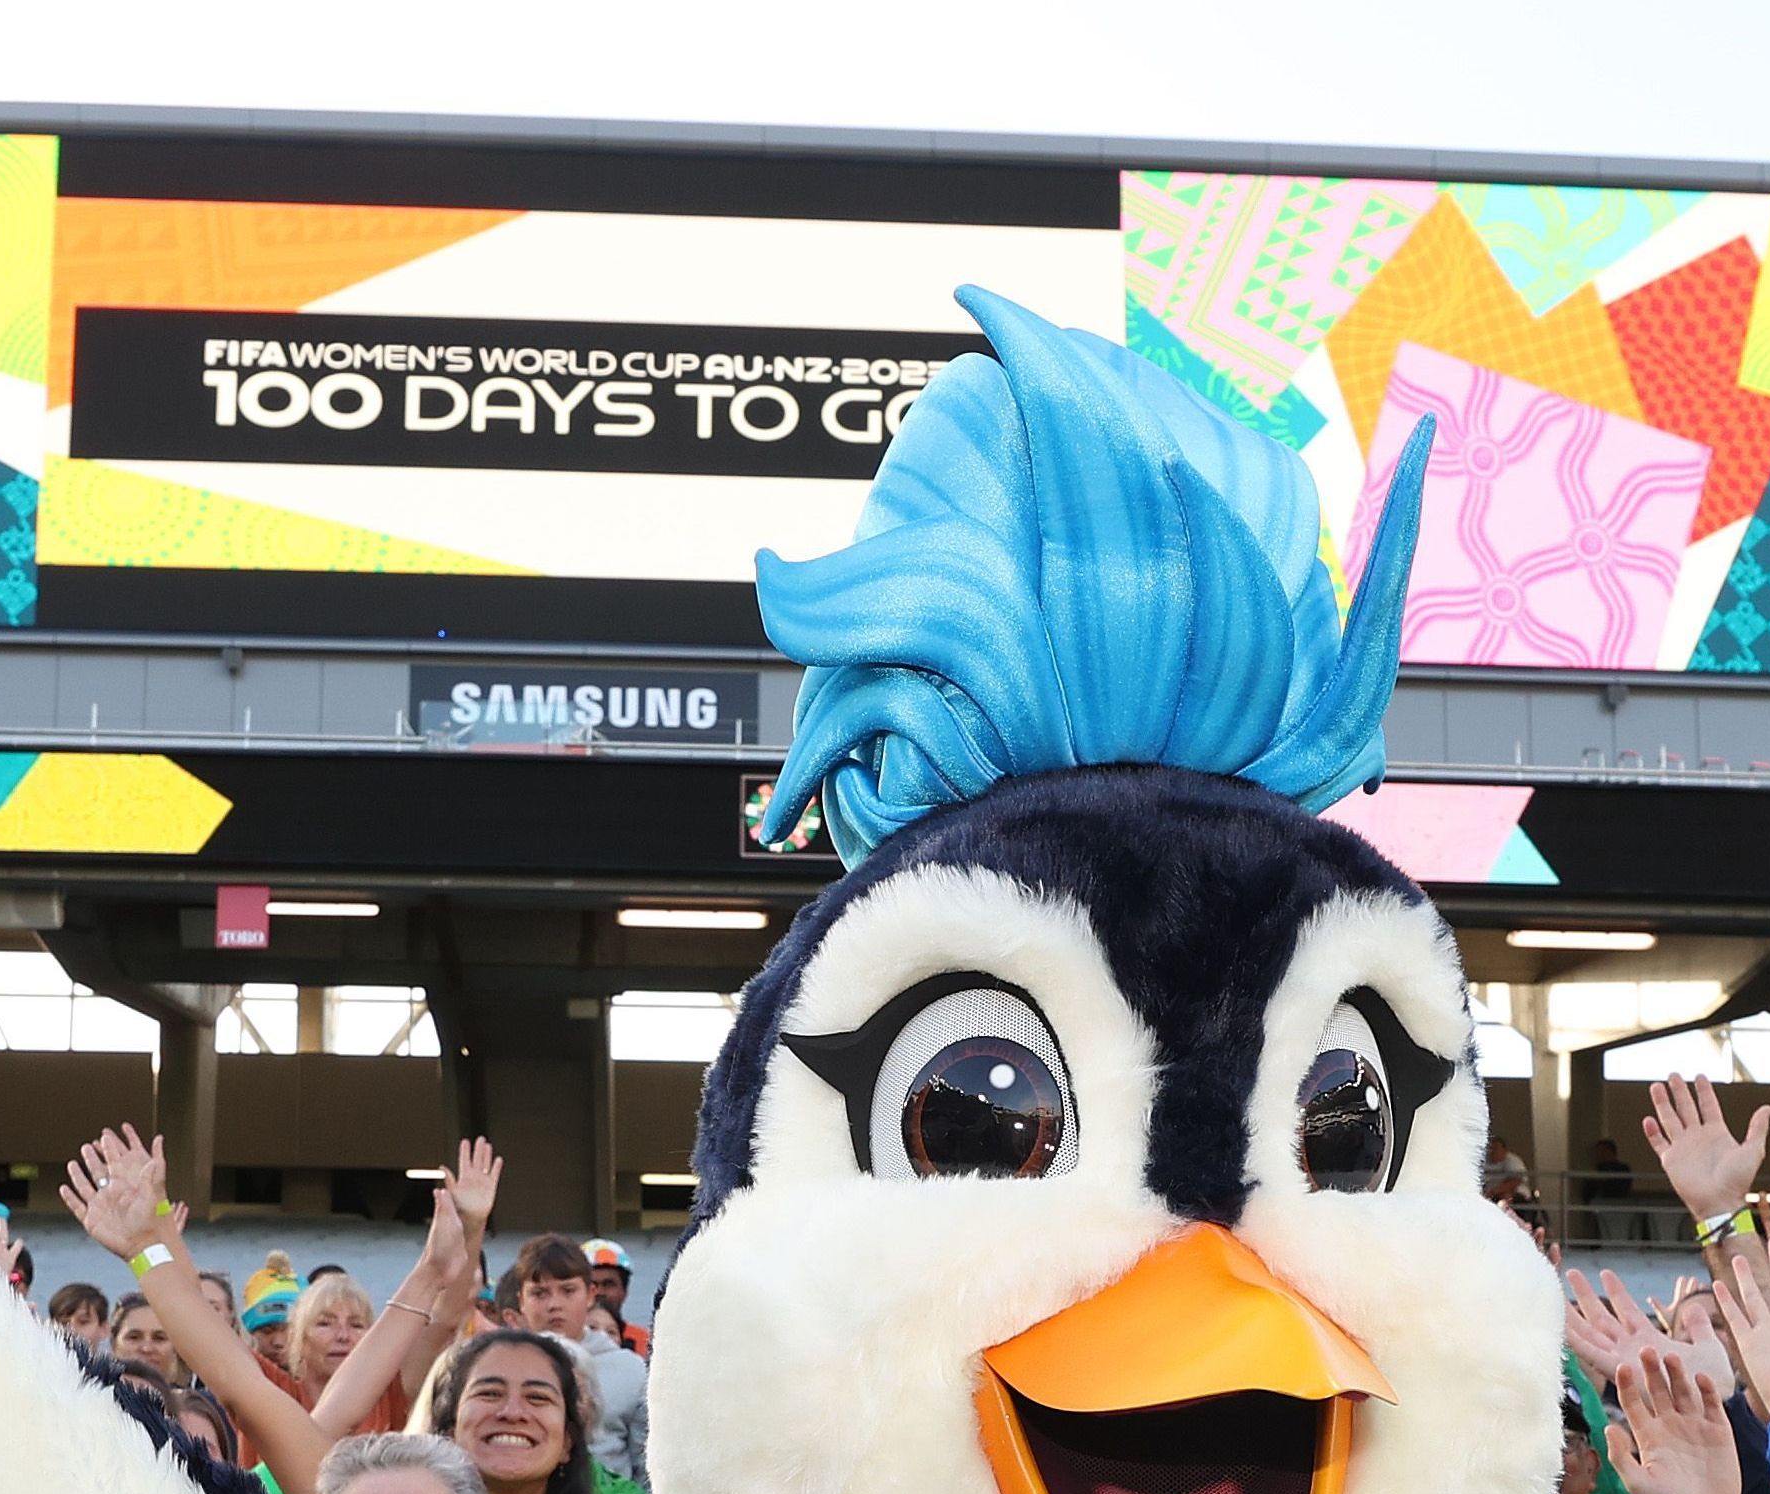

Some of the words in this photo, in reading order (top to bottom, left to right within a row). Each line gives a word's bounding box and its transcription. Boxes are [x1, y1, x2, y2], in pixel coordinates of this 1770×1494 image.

[204, 337, 286, 368] FIFA
[287, 341, 472, 374] WOMEN'S
[479, 347, 613, 377] WORLD
[622, 350, 700, 381] CUP
[203, 370, 381, 431] 100
[405, 379, 655, 438] DAYS
[674, 383, 800, 442] TO
[451, 681, 717, 729] SAMSUNG
